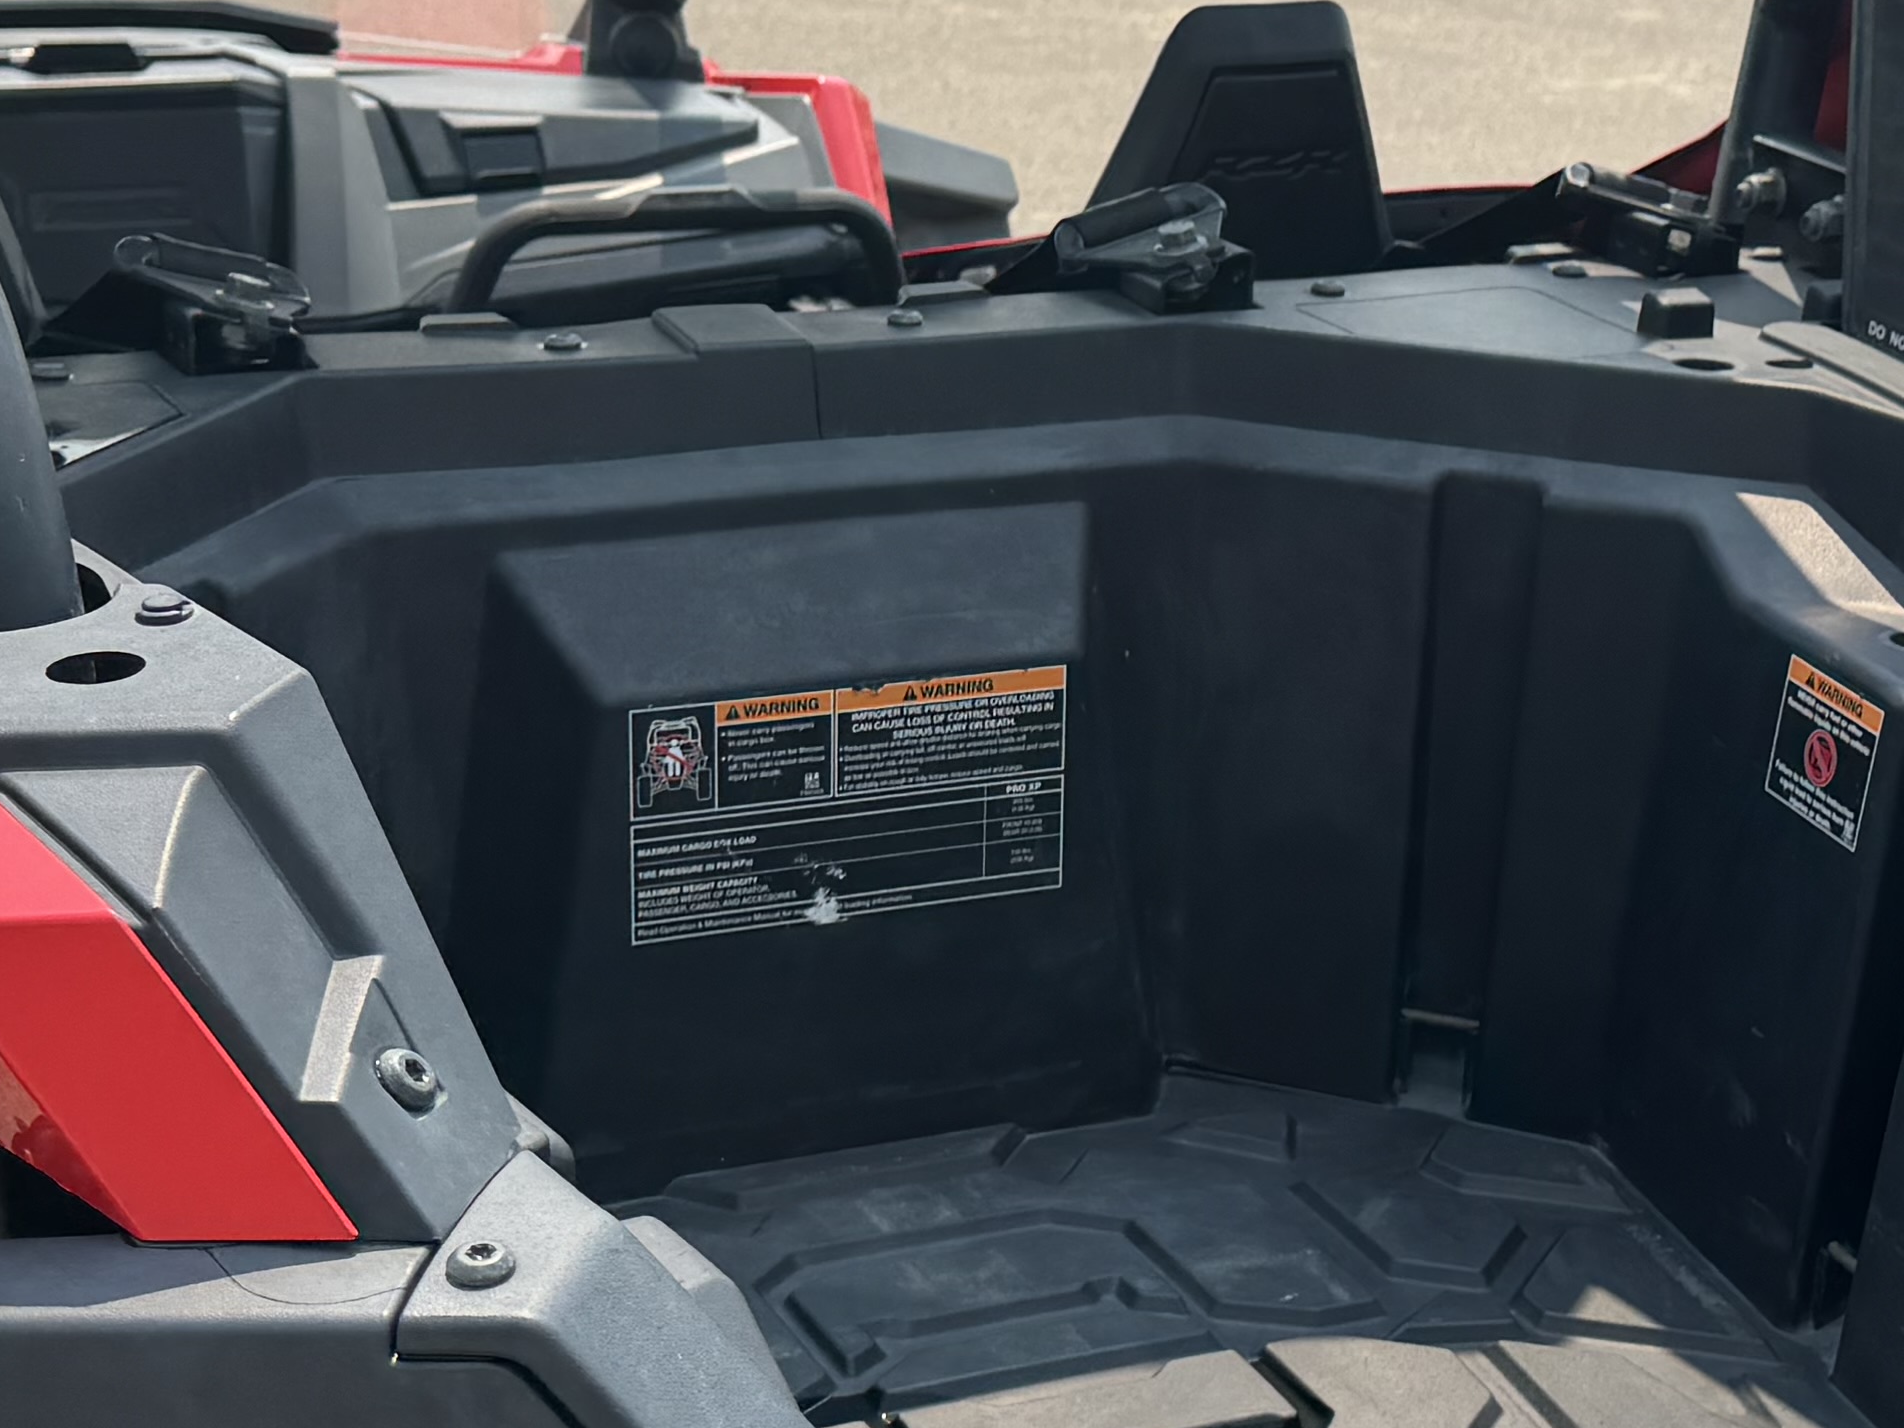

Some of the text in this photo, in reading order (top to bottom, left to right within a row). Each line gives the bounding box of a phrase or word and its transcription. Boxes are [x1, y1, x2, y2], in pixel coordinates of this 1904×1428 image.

[1868, 320, 1886, 340] DO
[920, 678, 994, 699] WARNING
[743, 697, 820, 718] WARNING
[1817, 680, 1864, 720] WARNING
[852, 723, 873, 733] CAN
[874, 718, 905, 730] CAUSE
[907, 715, 931, 726] LOSS
[947, 709, 991, 721] CONTROL
[1006, 784, 1026, 794] PRO
[637, 845, 680, 858] MAXIMUM
[681, 840, 712, 852] CARGO
[733, 835, 757, 846] LOAD
[637, 876, 758, 899] MAXIMUM WEIGHT CAPACITY
